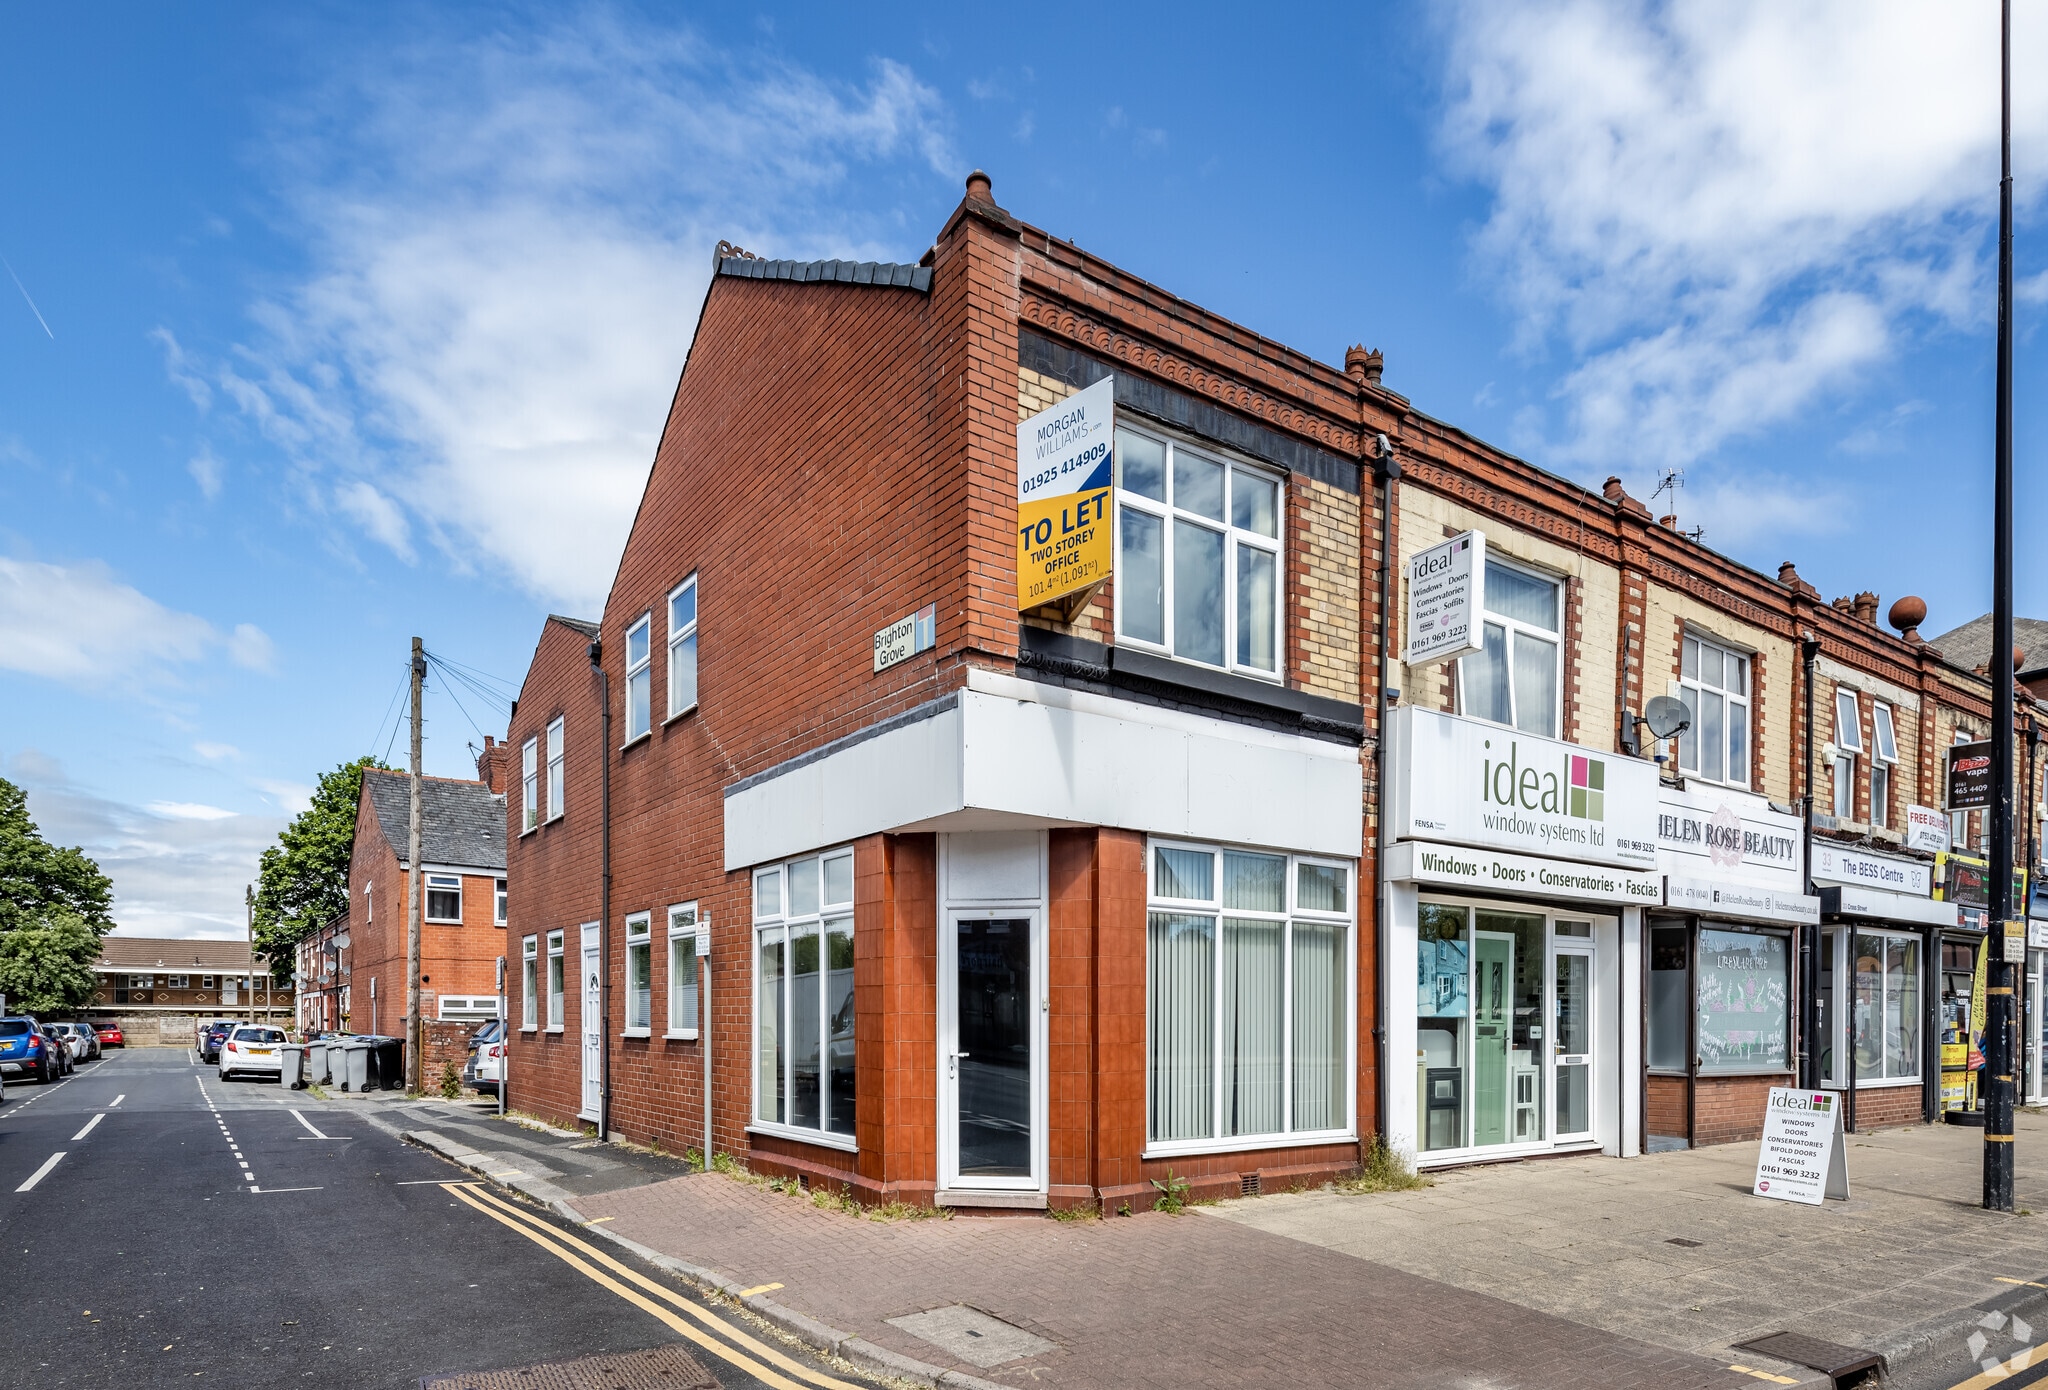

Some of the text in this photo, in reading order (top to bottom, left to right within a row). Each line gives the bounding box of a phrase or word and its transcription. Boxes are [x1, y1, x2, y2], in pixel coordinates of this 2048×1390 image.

[1037, 406, 1085, 443] MORGAN
[1023, 442, 1106, 494] 01925 414909
[1020, 490, 1109, 552] TO LET
[1030, 527, 1095, 565] TWO STOREY
[1045, 550, 1080, 575] OFFICE
[1414, 546, 1453, 580] ideal
[1413, 571, 1469, 598] Windows Doors
[1416, 585, 1465, 608] Conservatories
[1416, 606, 1439, 620] Fascias
[1443, 597, 1464, 611] Soffits
[875, 622, 913, 650] Brighton
[1411, 624, 1467, 650] 0161 969 3223
[879, 645, 905, 666] Grove
[1484, 740, 1569, 816] ideal
[1966, 768, 1989, 777] vape
[1969, 784, 1988, 793] 4409
[1414, 819, 1434, 829] FENSA
[1483, 810, 1604, 847] window systems ltd
[1909, 811, 1928, 824] FREE
[1617, 838, 1655, 853] 0161 969 3232
[1705, 822, 1741, 850] ROSE
[1743, 831, 1795, 859] BEAUTY
[1822, 852, 1832, 866] 33
[1421, 852, 1658, 897] Windows Doors Conservatories Fascias
[1842, 858, 1904, 883] The BESS Centre
[1670, 885, 1683, 897] 0161
[1771, 1091, 1813, 1111] ideal
[1770, 1107, 1795, 1115] window
[1796, 1110, 1821, 1118] systems
[1781, 1118, 1815, 1128] WINDOWS
[1767, 1135, 1824, 1149] CONSERVATORIES
[1784, 1128, 1808, 1137] DOORS
[1770, 1145, 1817, 1158] BIFOLD DOORS
[1778, 1156, 1805, 1166] FASCIAS
[1761, 1164, 1820, 1180] 0161 969 3232
